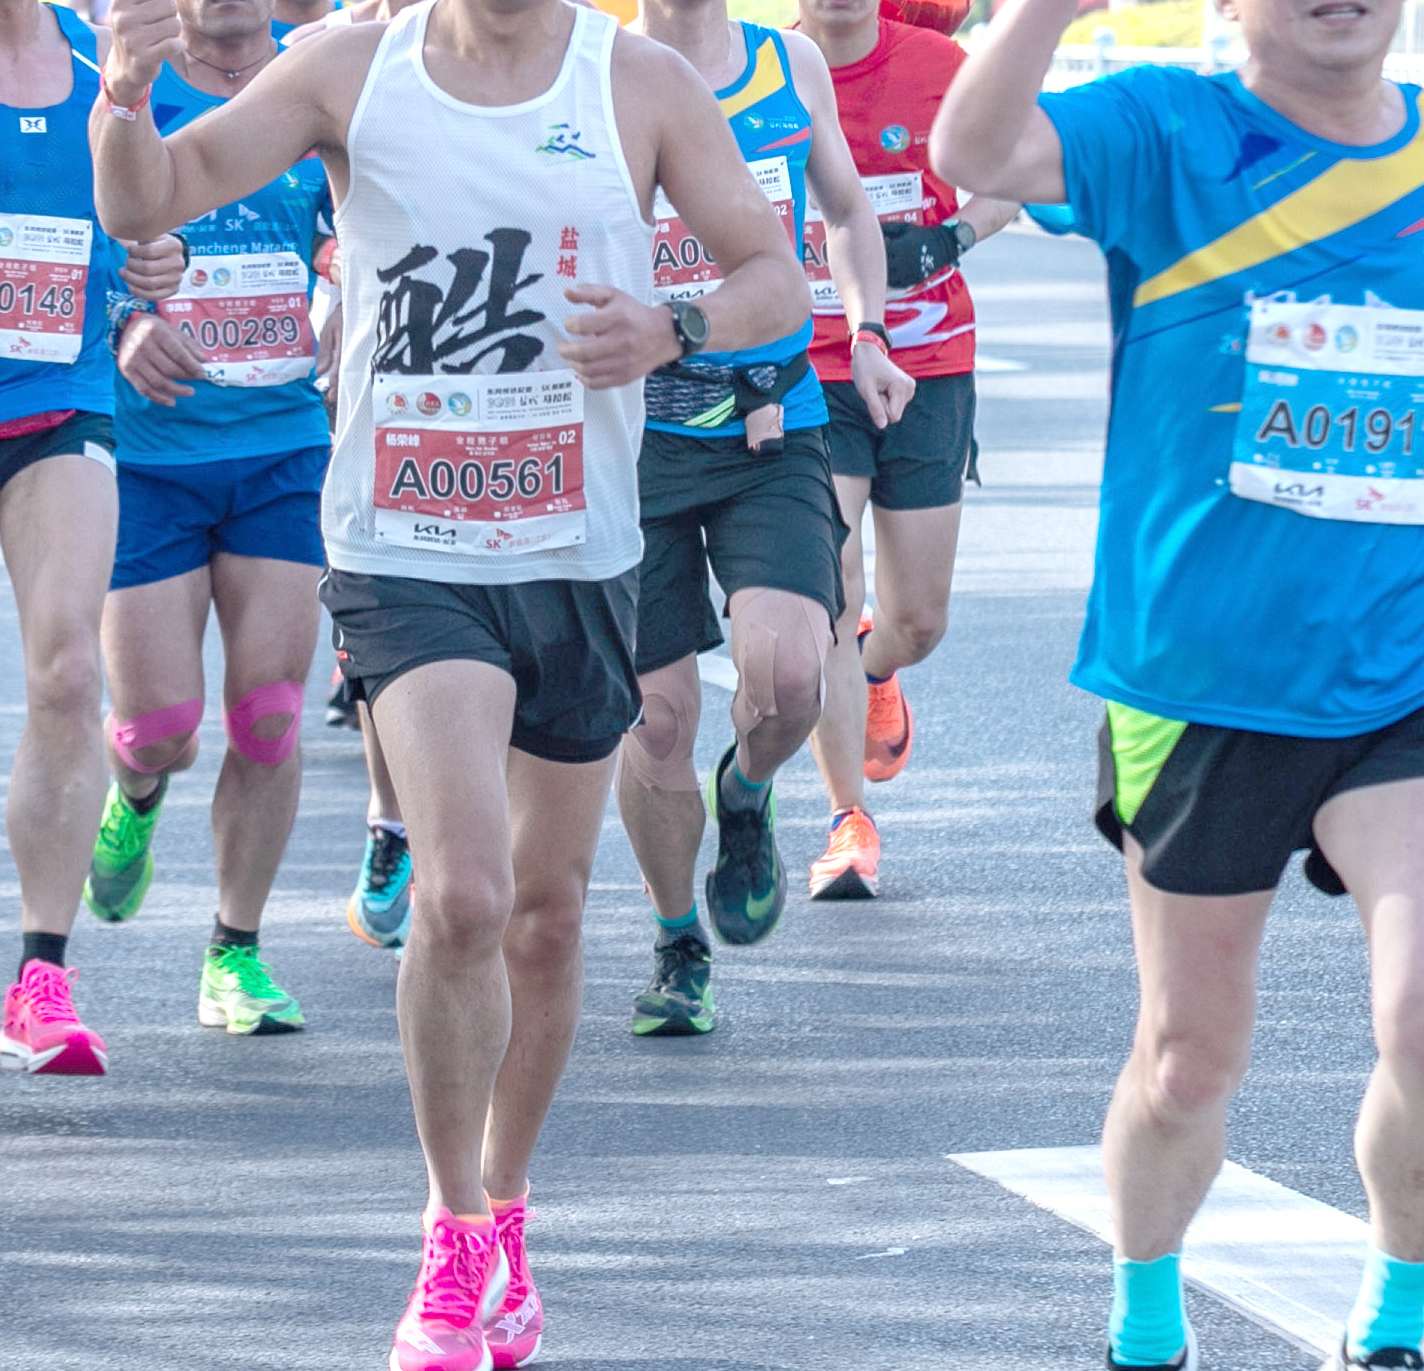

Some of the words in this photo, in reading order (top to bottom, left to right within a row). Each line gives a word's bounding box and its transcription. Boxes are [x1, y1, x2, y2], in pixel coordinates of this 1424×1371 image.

[226, 219, 245, 232] SK
[188, 242, 247, 255] ancheng
[556, 226, 580, 279] 盐城
[70, 269, 84, 281] 01
[288, 296, 301, 308] 01
[372, 227, 546, 376] 酷
[385, 432, 421, 448] 杨荣峰
[558, 429, 577, 445] 02
[389, 452, 564, 502] A00561
[414, 523, 457, 538] KIA
[486, 538, 501, 549] SK
